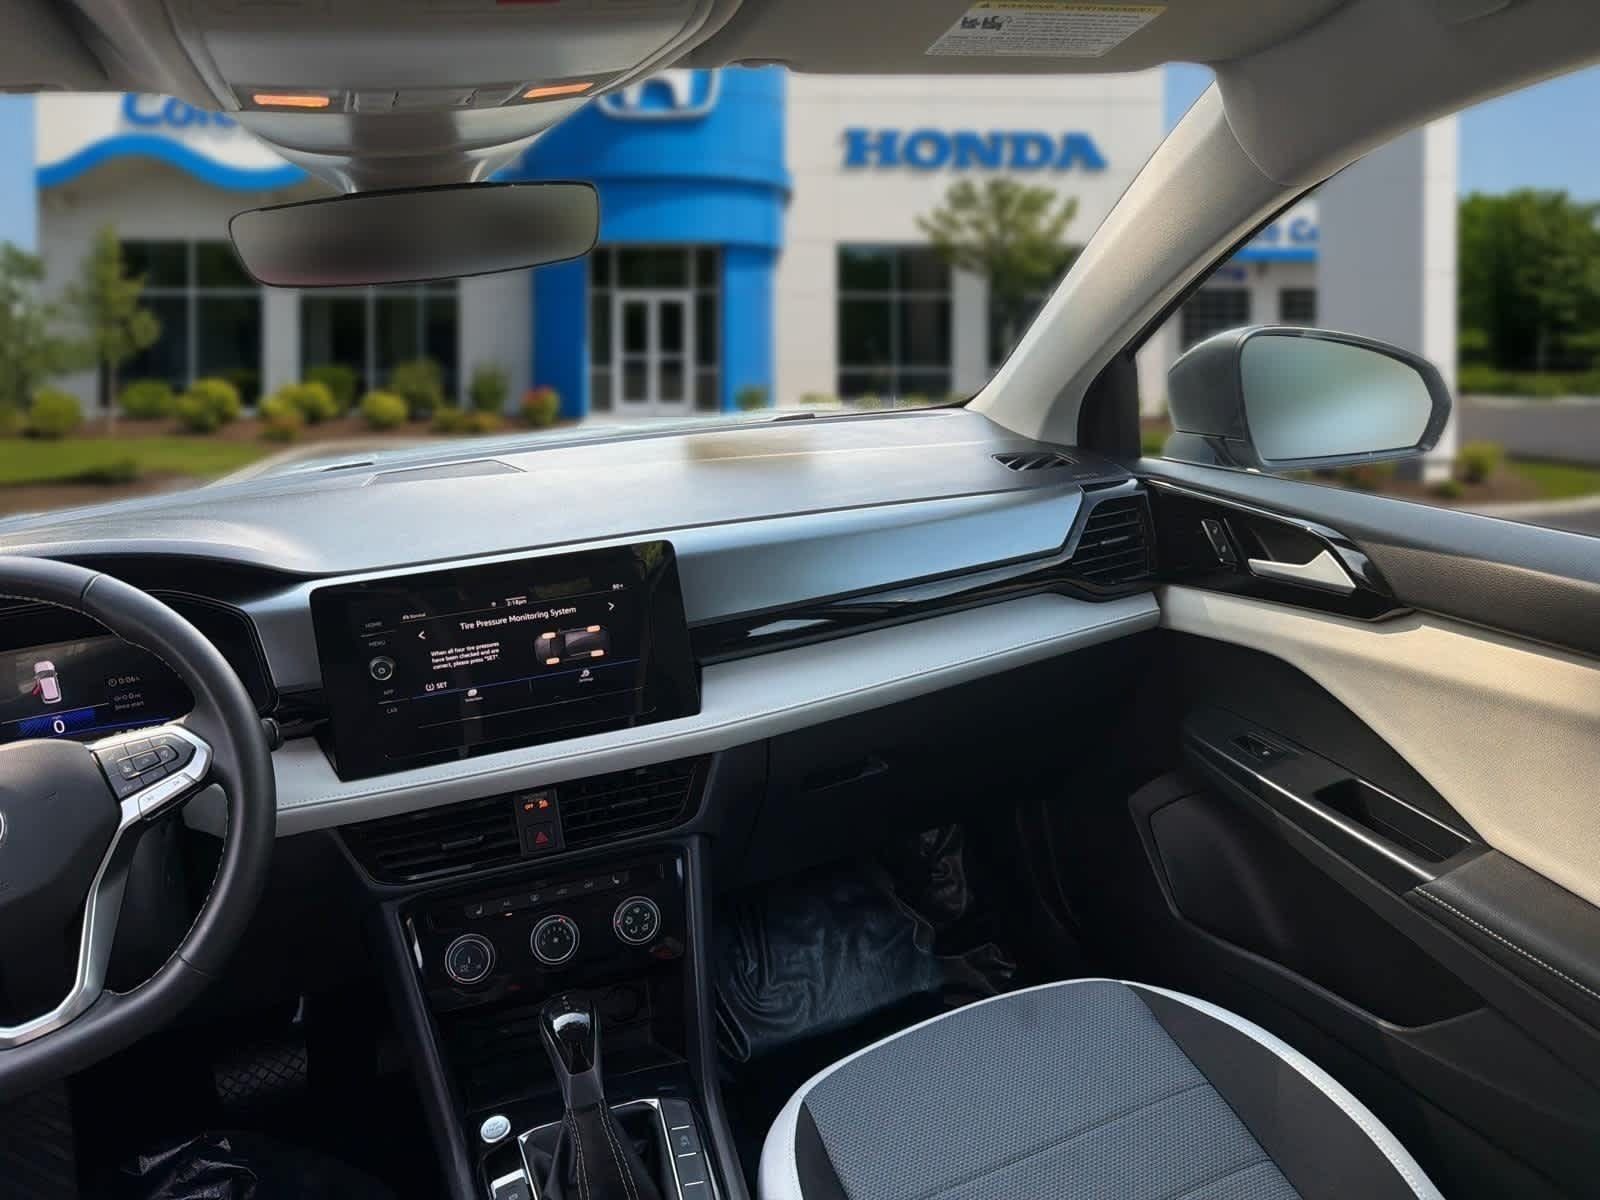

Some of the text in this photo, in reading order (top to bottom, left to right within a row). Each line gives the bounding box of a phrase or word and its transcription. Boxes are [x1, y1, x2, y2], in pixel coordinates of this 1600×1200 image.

[844, 127, 1108, 172] HONDA
[459, 607, 577, 631] Tire Pressure Monitoring System
[436, 681, 448, 689] SET
[53, 719, 65, 734] 0
